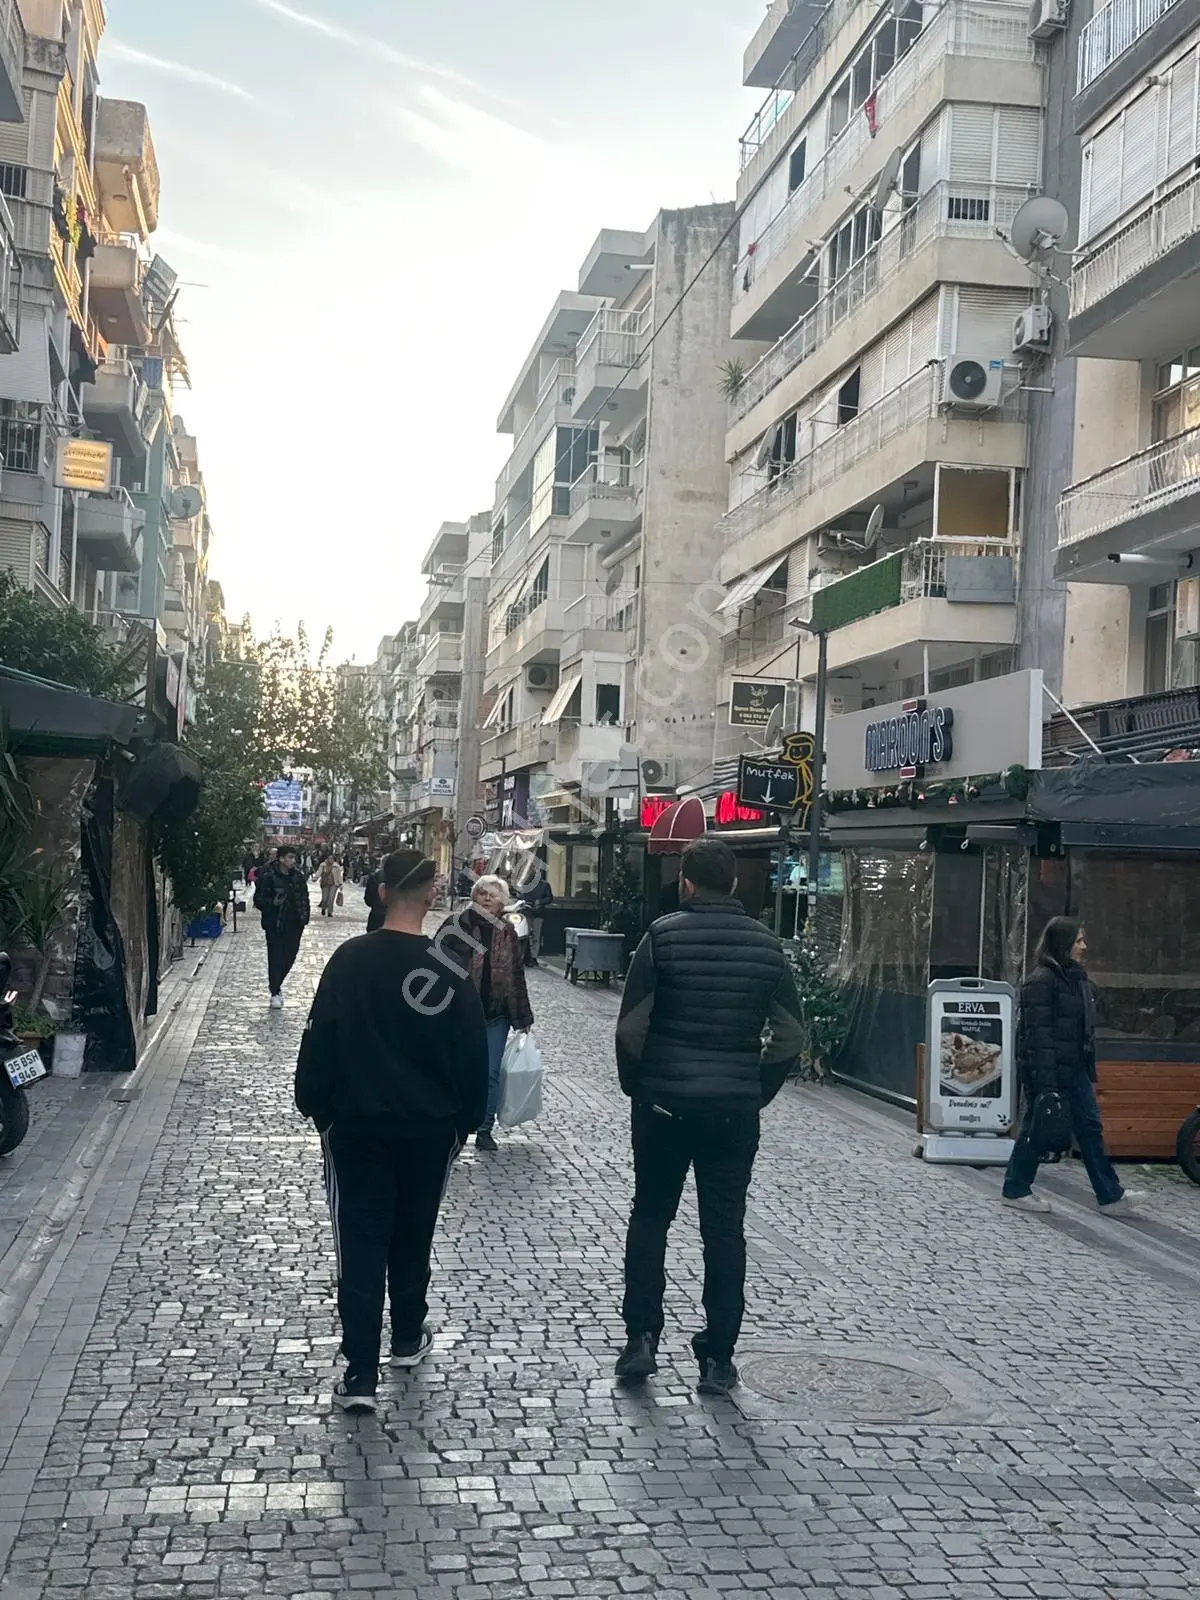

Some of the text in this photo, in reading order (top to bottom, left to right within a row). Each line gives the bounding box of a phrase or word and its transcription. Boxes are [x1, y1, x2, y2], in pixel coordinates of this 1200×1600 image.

[958, 1002, 985, 1014] ERVA
[8, 1052, 39, 1073] 35 BSH
[19, 1067, 37, 1082] 946
